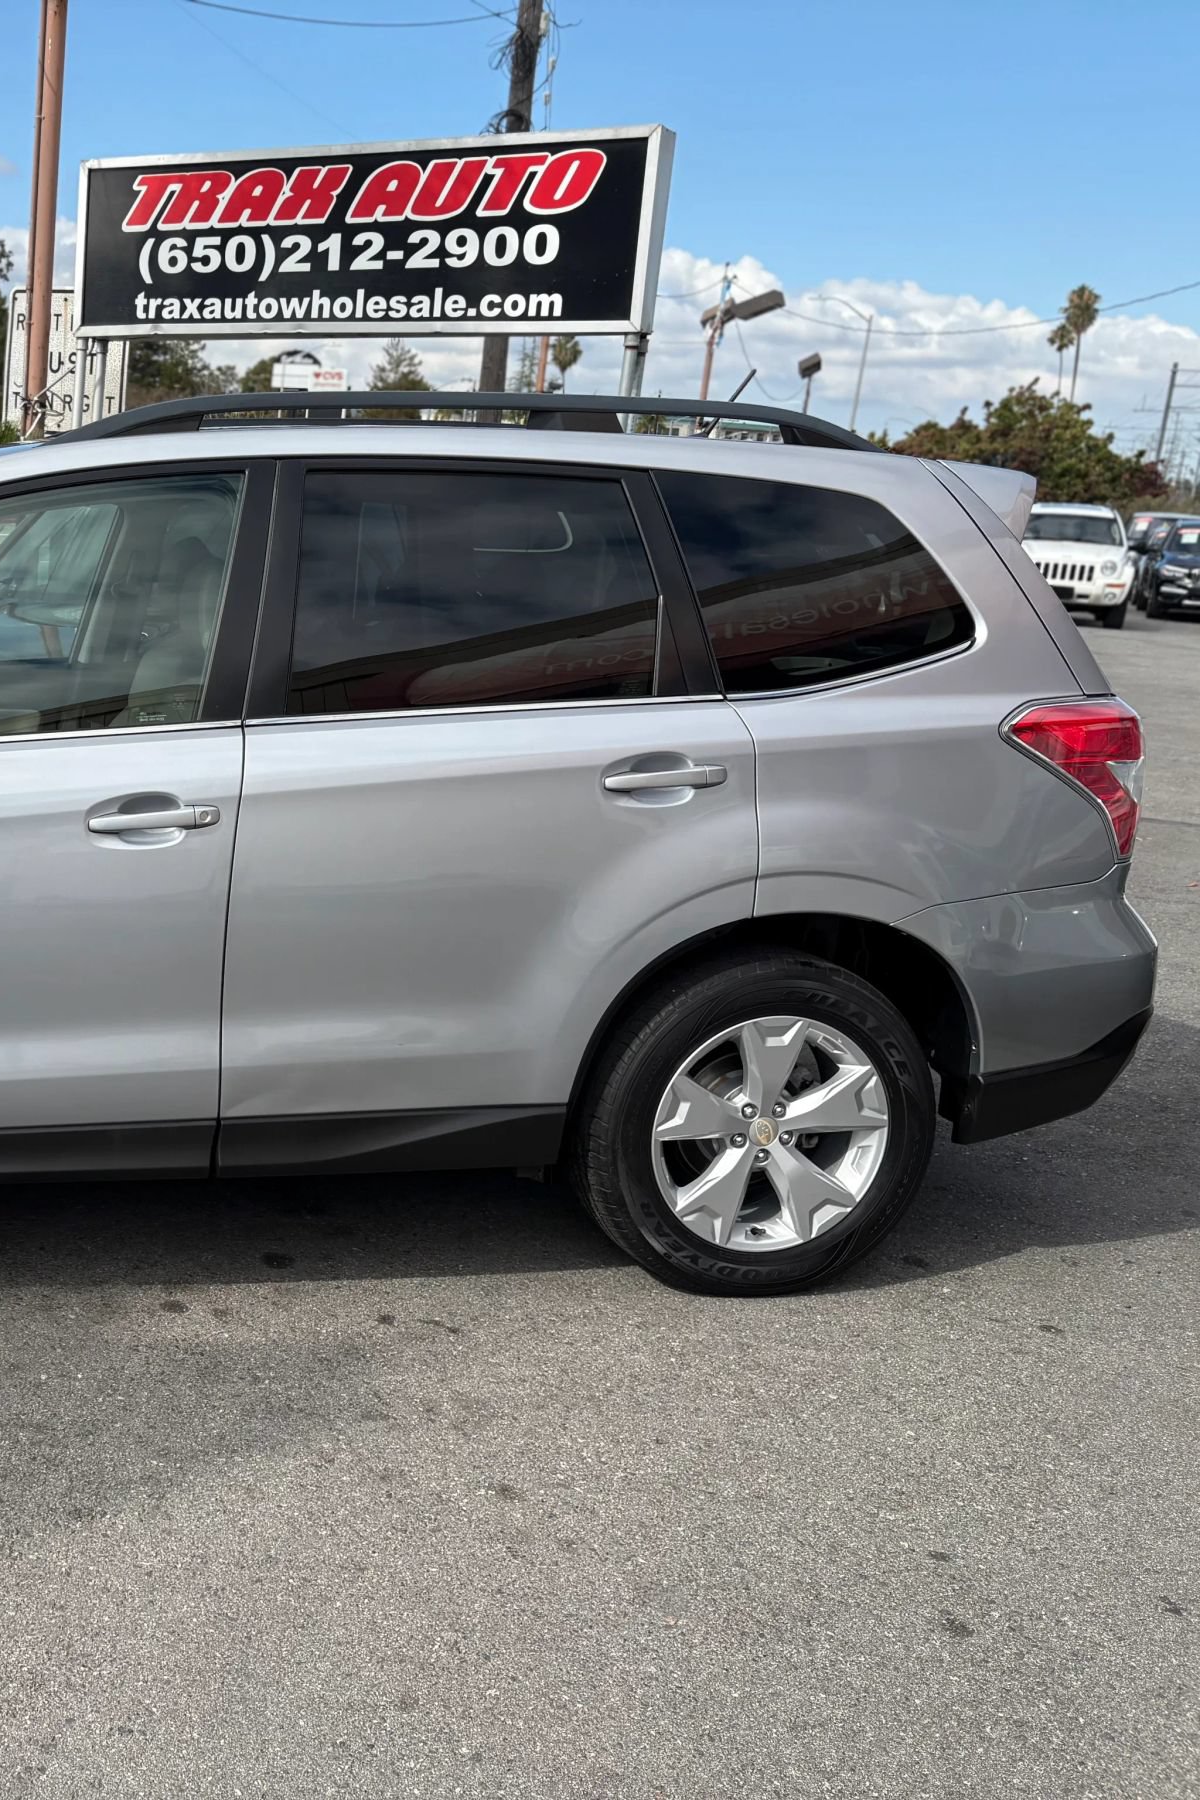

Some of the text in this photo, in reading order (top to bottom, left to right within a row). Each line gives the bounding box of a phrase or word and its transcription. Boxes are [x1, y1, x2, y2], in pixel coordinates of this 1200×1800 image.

[121, 148, 607, 232] TRAX AUTO
[138, 224, 560, 285] (650)212-2900
[135, 287, 563, 321] traxautowholesale.com
